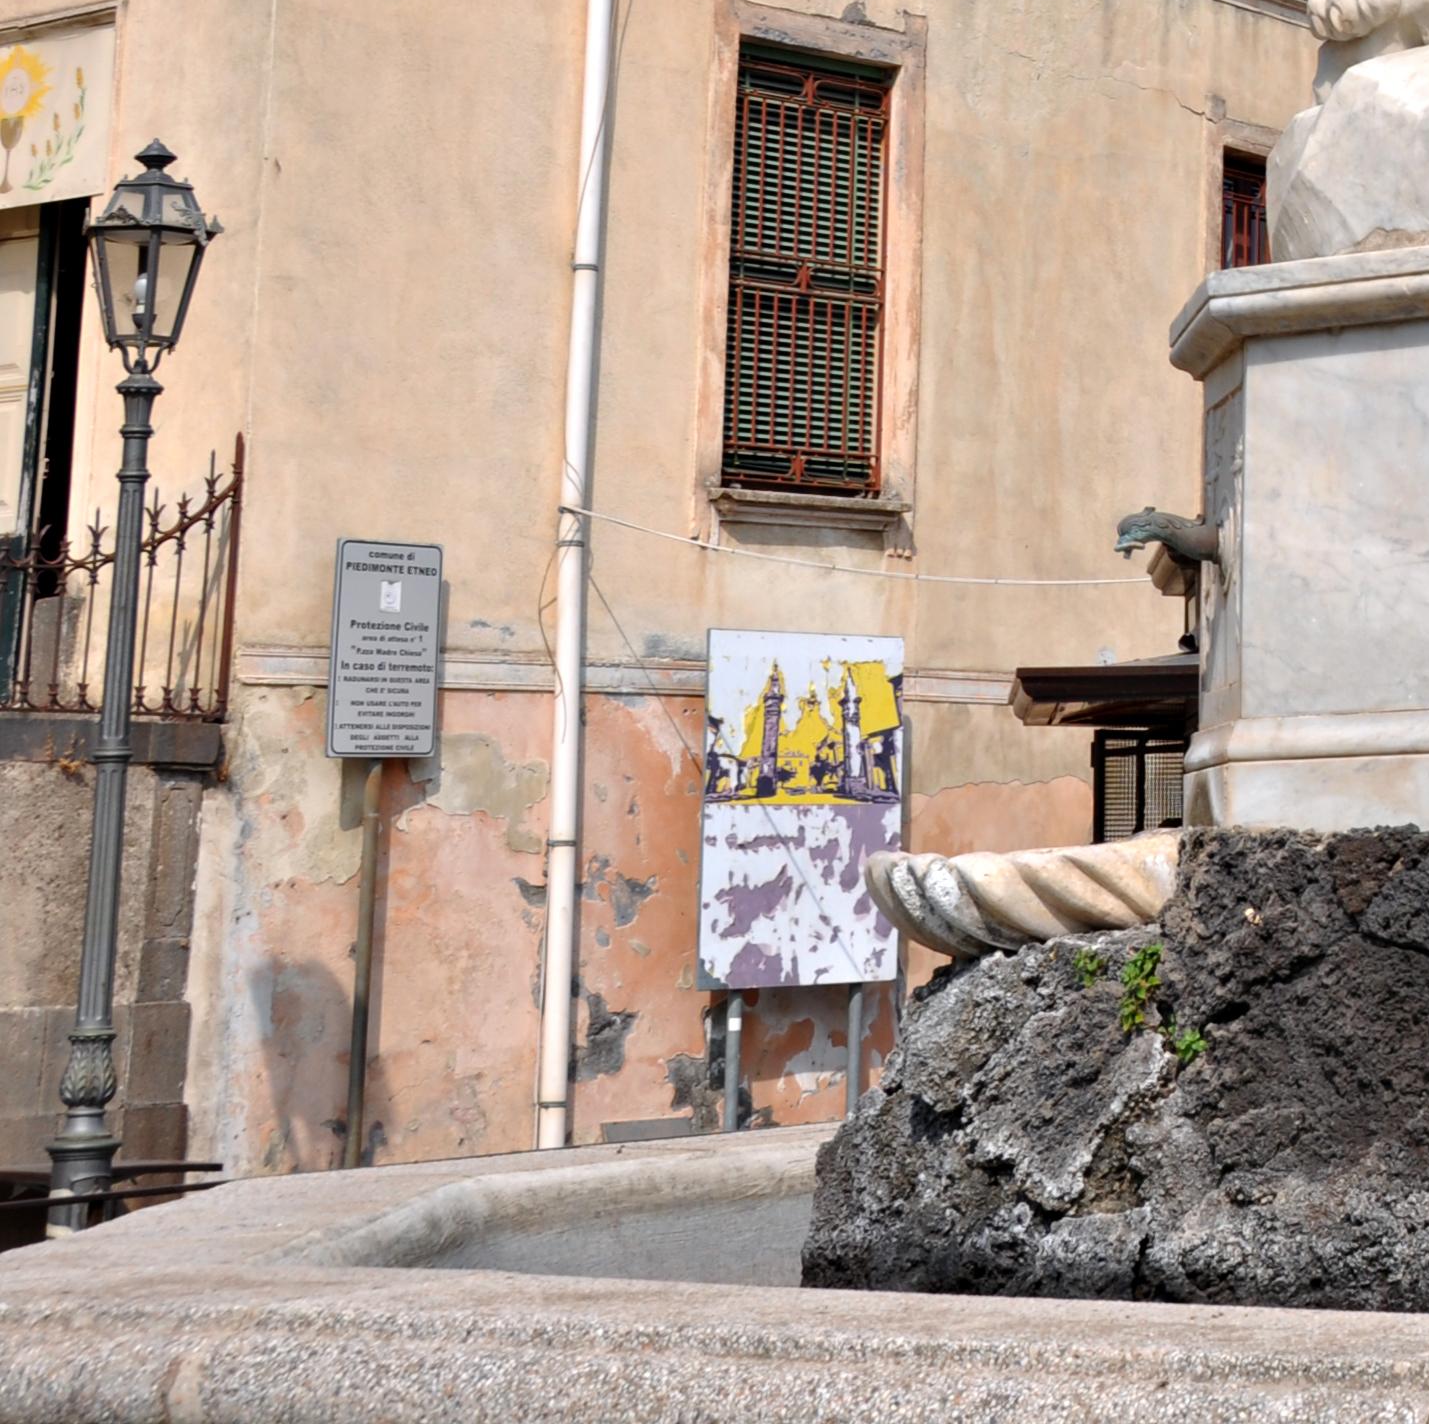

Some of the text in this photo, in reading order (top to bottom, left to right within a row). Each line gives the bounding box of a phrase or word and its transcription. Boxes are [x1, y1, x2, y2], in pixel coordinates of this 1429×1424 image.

[368, 551, 416, 561] comune di
[346, 561, 438, 577] PIEDIMONTE ETNEO
[350, 619, 429, 632] Protezione Civile
[340, 660, 434, 673] In caso di terremoto:
